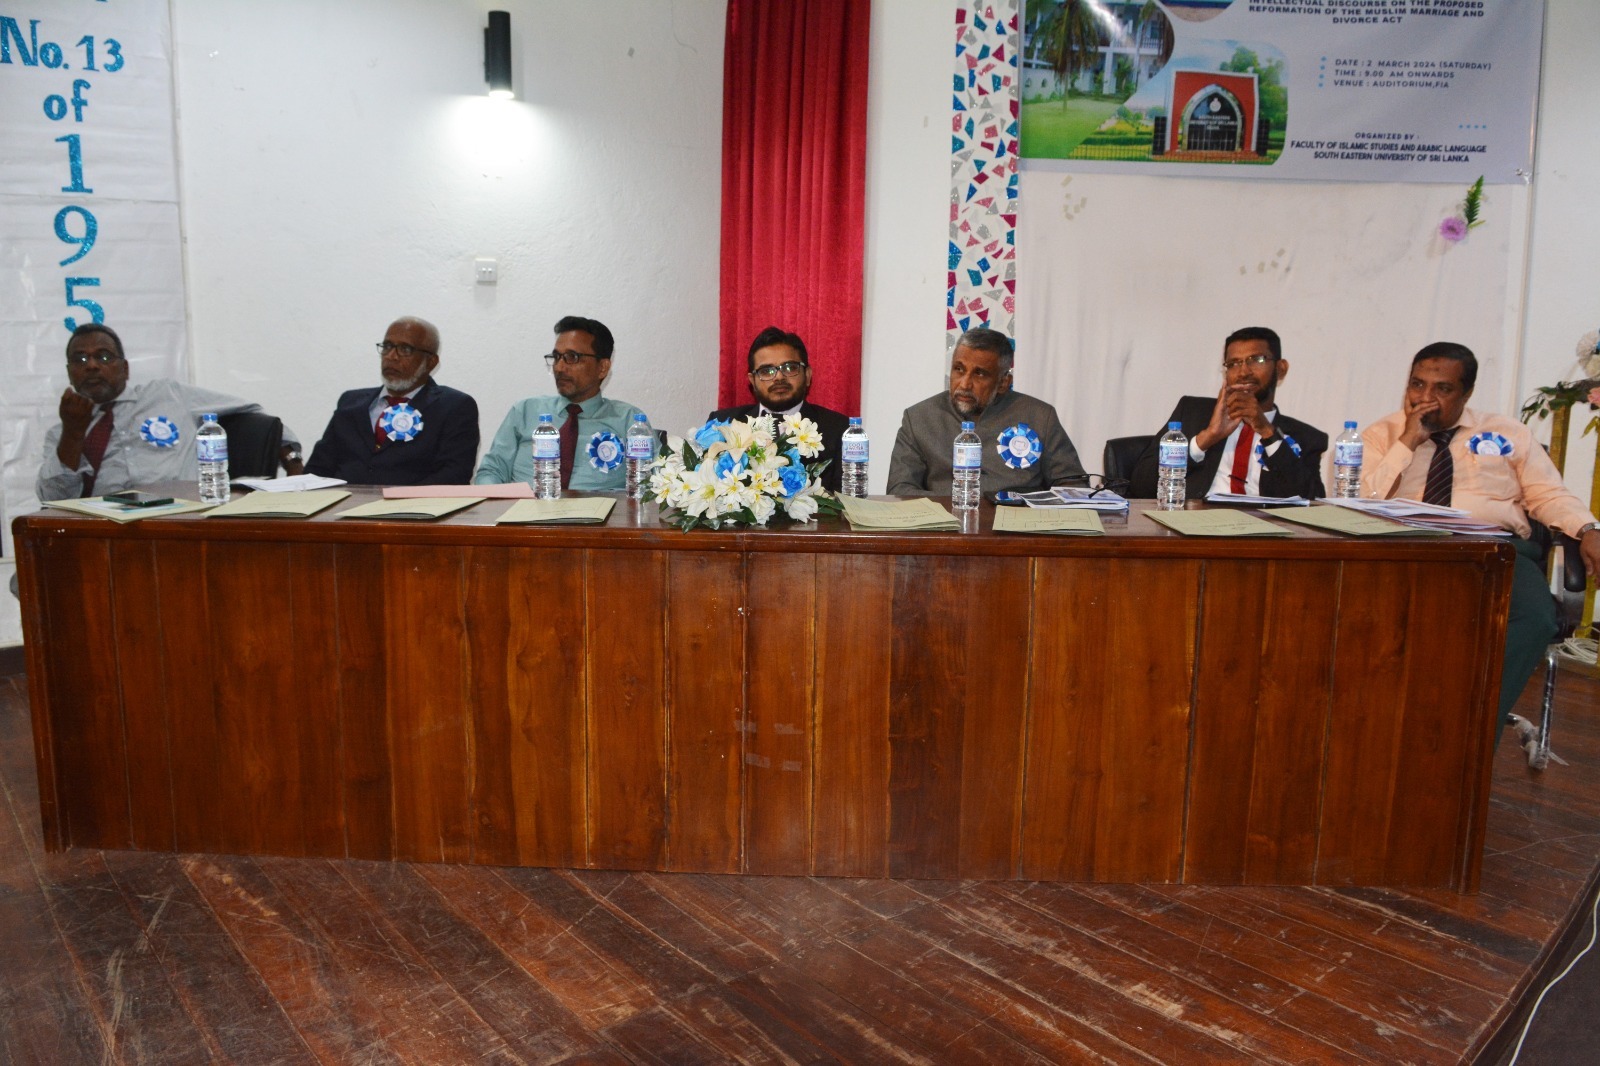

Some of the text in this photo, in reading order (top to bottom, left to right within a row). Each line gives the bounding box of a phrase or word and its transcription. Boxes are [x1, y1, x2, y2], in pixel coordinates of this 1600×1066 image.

[1434, 0, 1484, 9] PROPOSED
[1249, 5, 1321, 14] REFORMATION
[1410, 8, 1460, 17] MARRIAGE
[1332, 16, 1403, 24] DIVORCE ACT
[0, 15, 125, 73] No. 13
[1335, 58, 1359, 66] DATE
[1367, 59, 1372, 67] 2
[1378, 60, 1410, 68] MARCH
[1440, 60, 1492, 70] (SATURDAY)
[43, 79, 91, 122] of
[1355, 132, 1402, 140] ORGANIZED
[1291, 140, 1487, 153] FACULTY OF ISLAMIC STUDIES AND ARABIC LANGUAGE
[1314, 151, 1339, 159] SOUTH
[1340, 151, 1373, 160] EASTERN
[1374, 152, 1416, 161] UNIVERSITY
[1416, 153, 1428, 161] OF
[1442, 154, 1470, 162] LANKA
